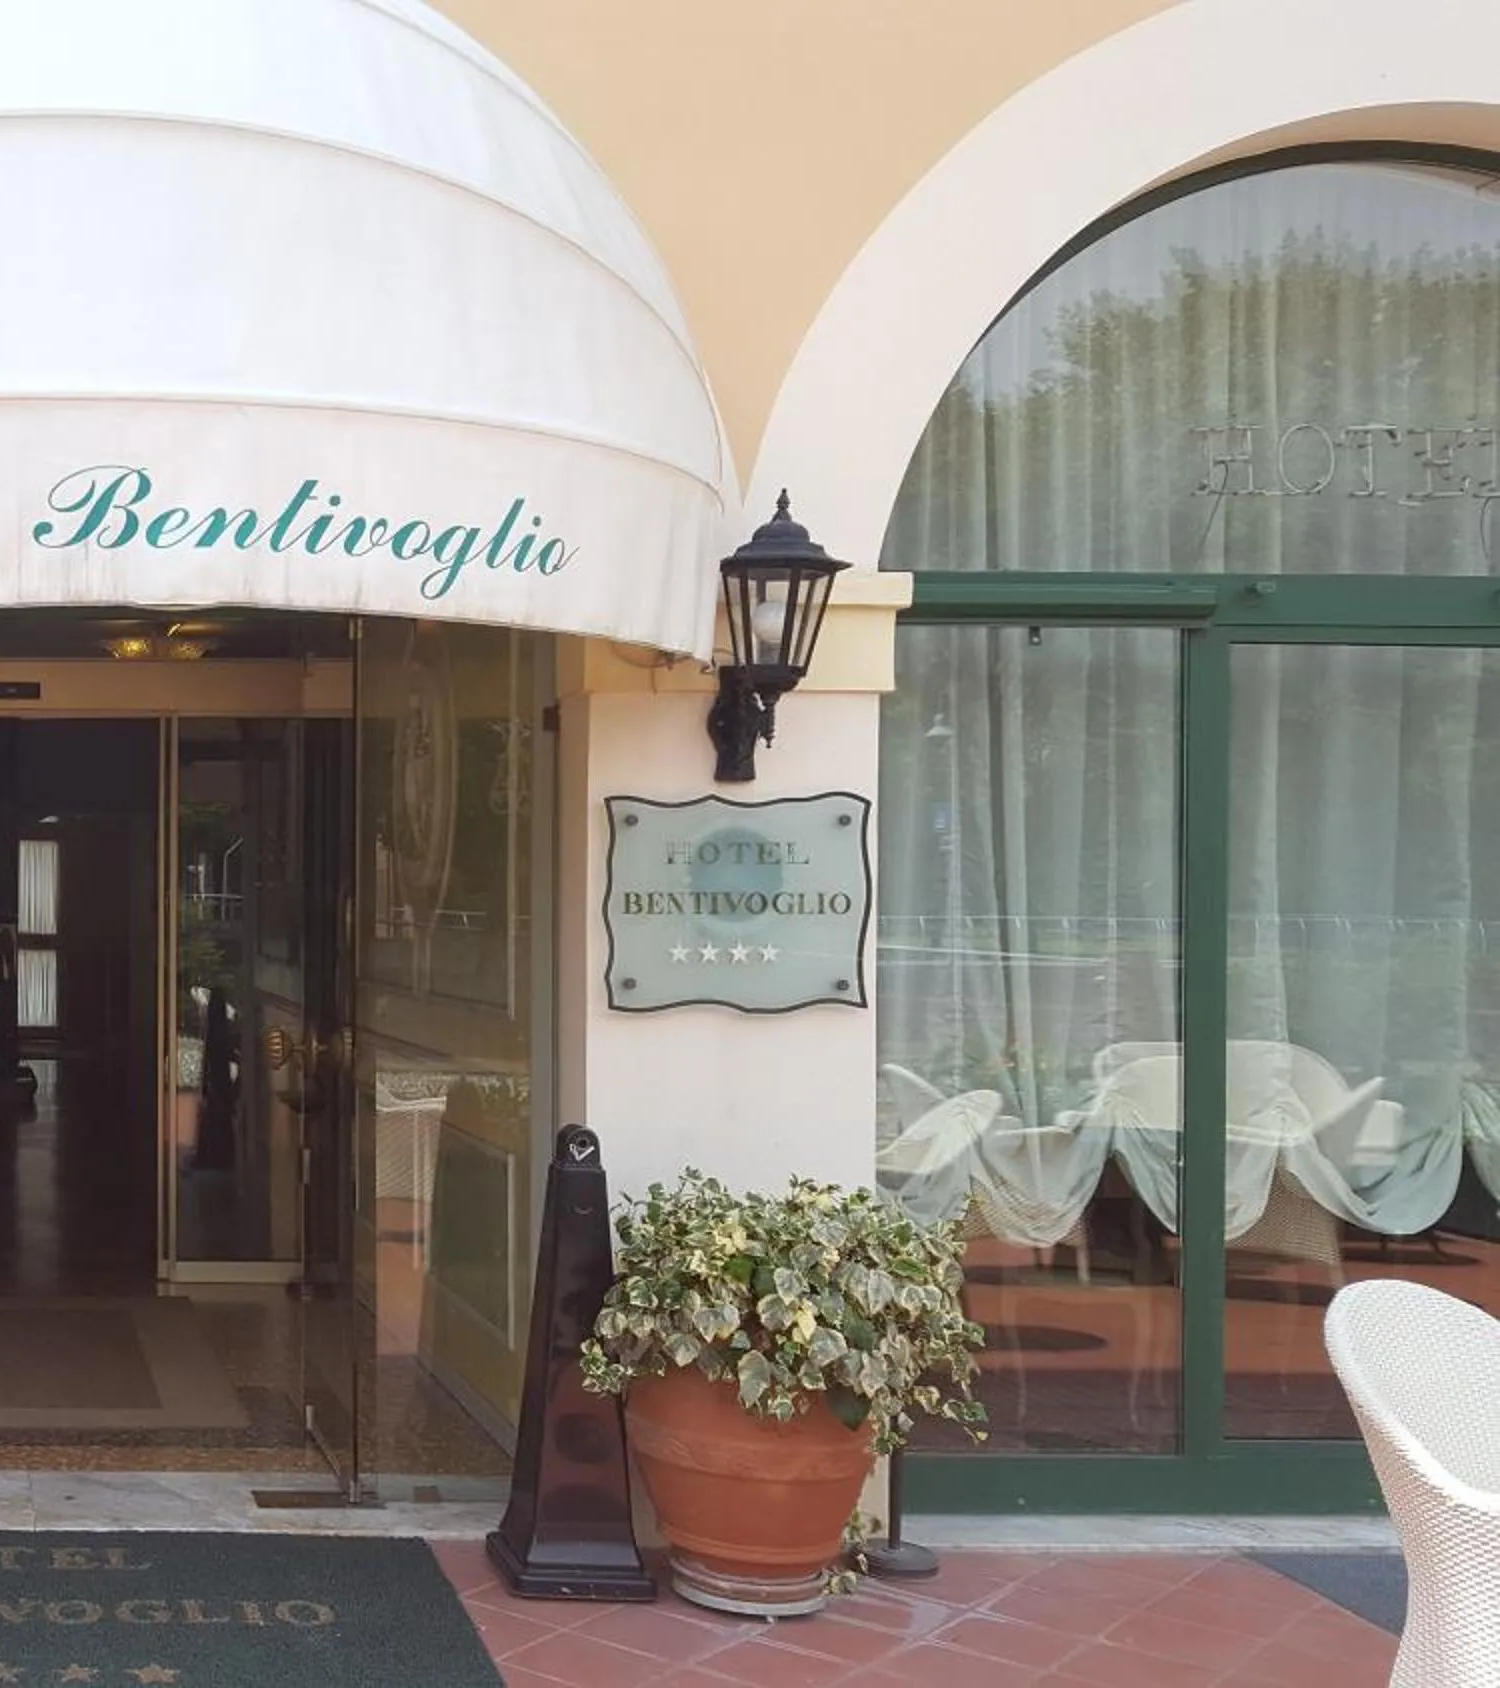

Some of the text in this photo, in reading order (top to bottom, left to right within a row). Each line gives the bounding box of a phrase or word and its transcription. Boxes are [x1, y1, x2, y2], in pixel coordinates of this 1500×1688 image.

[32, 464, 581, 600] Bentivoglio
[662, 840, 810, 865] HOTEL
[621, 890, 852, 916] BENTIVOGLIO
